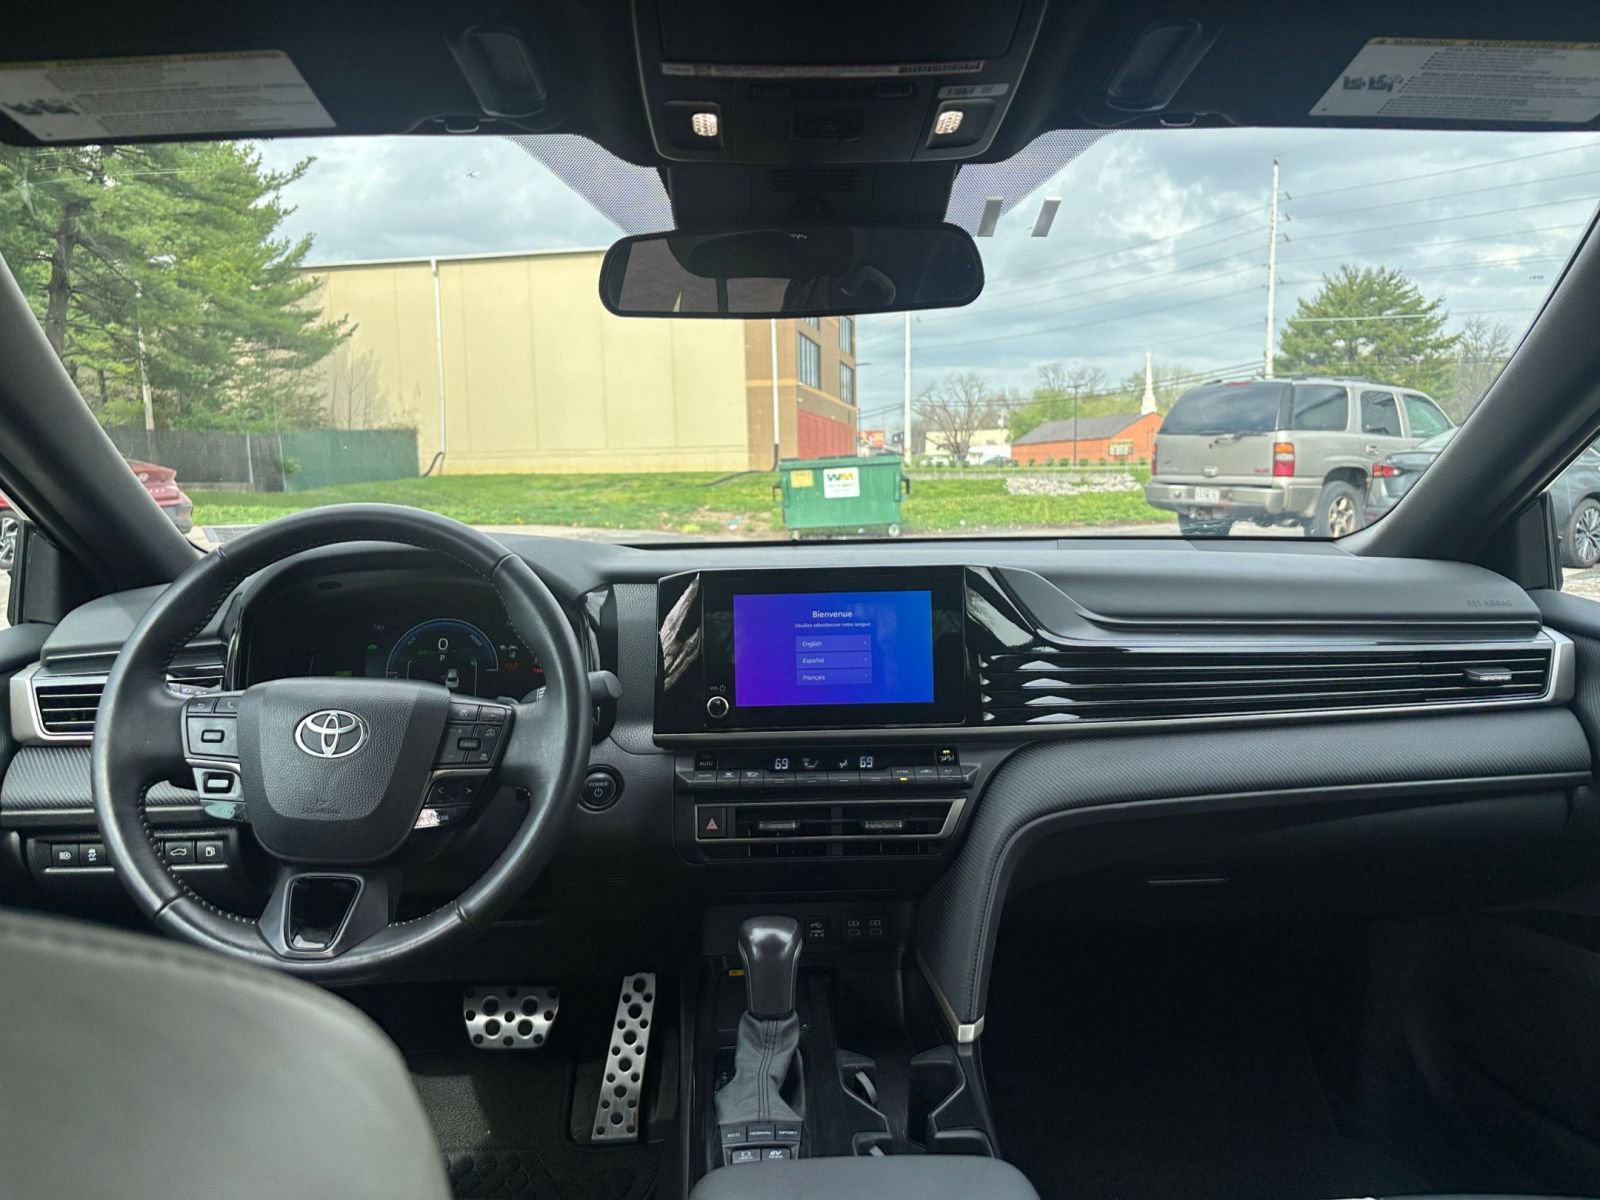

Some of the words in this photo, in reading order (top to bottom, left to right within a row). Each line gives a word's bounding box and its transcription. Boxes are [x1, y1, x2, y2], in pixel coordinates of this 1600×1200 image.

[827, 472, 854, 481] WM
[812, 610, 853, 619] Bienvenue
[802, 640, 822, 648] English
[802, 657, 825, 665] Español
[803, 674, 826, 682] Français
[775, 758, 788, 769] 69
[860, 756, 873, 768] 69
